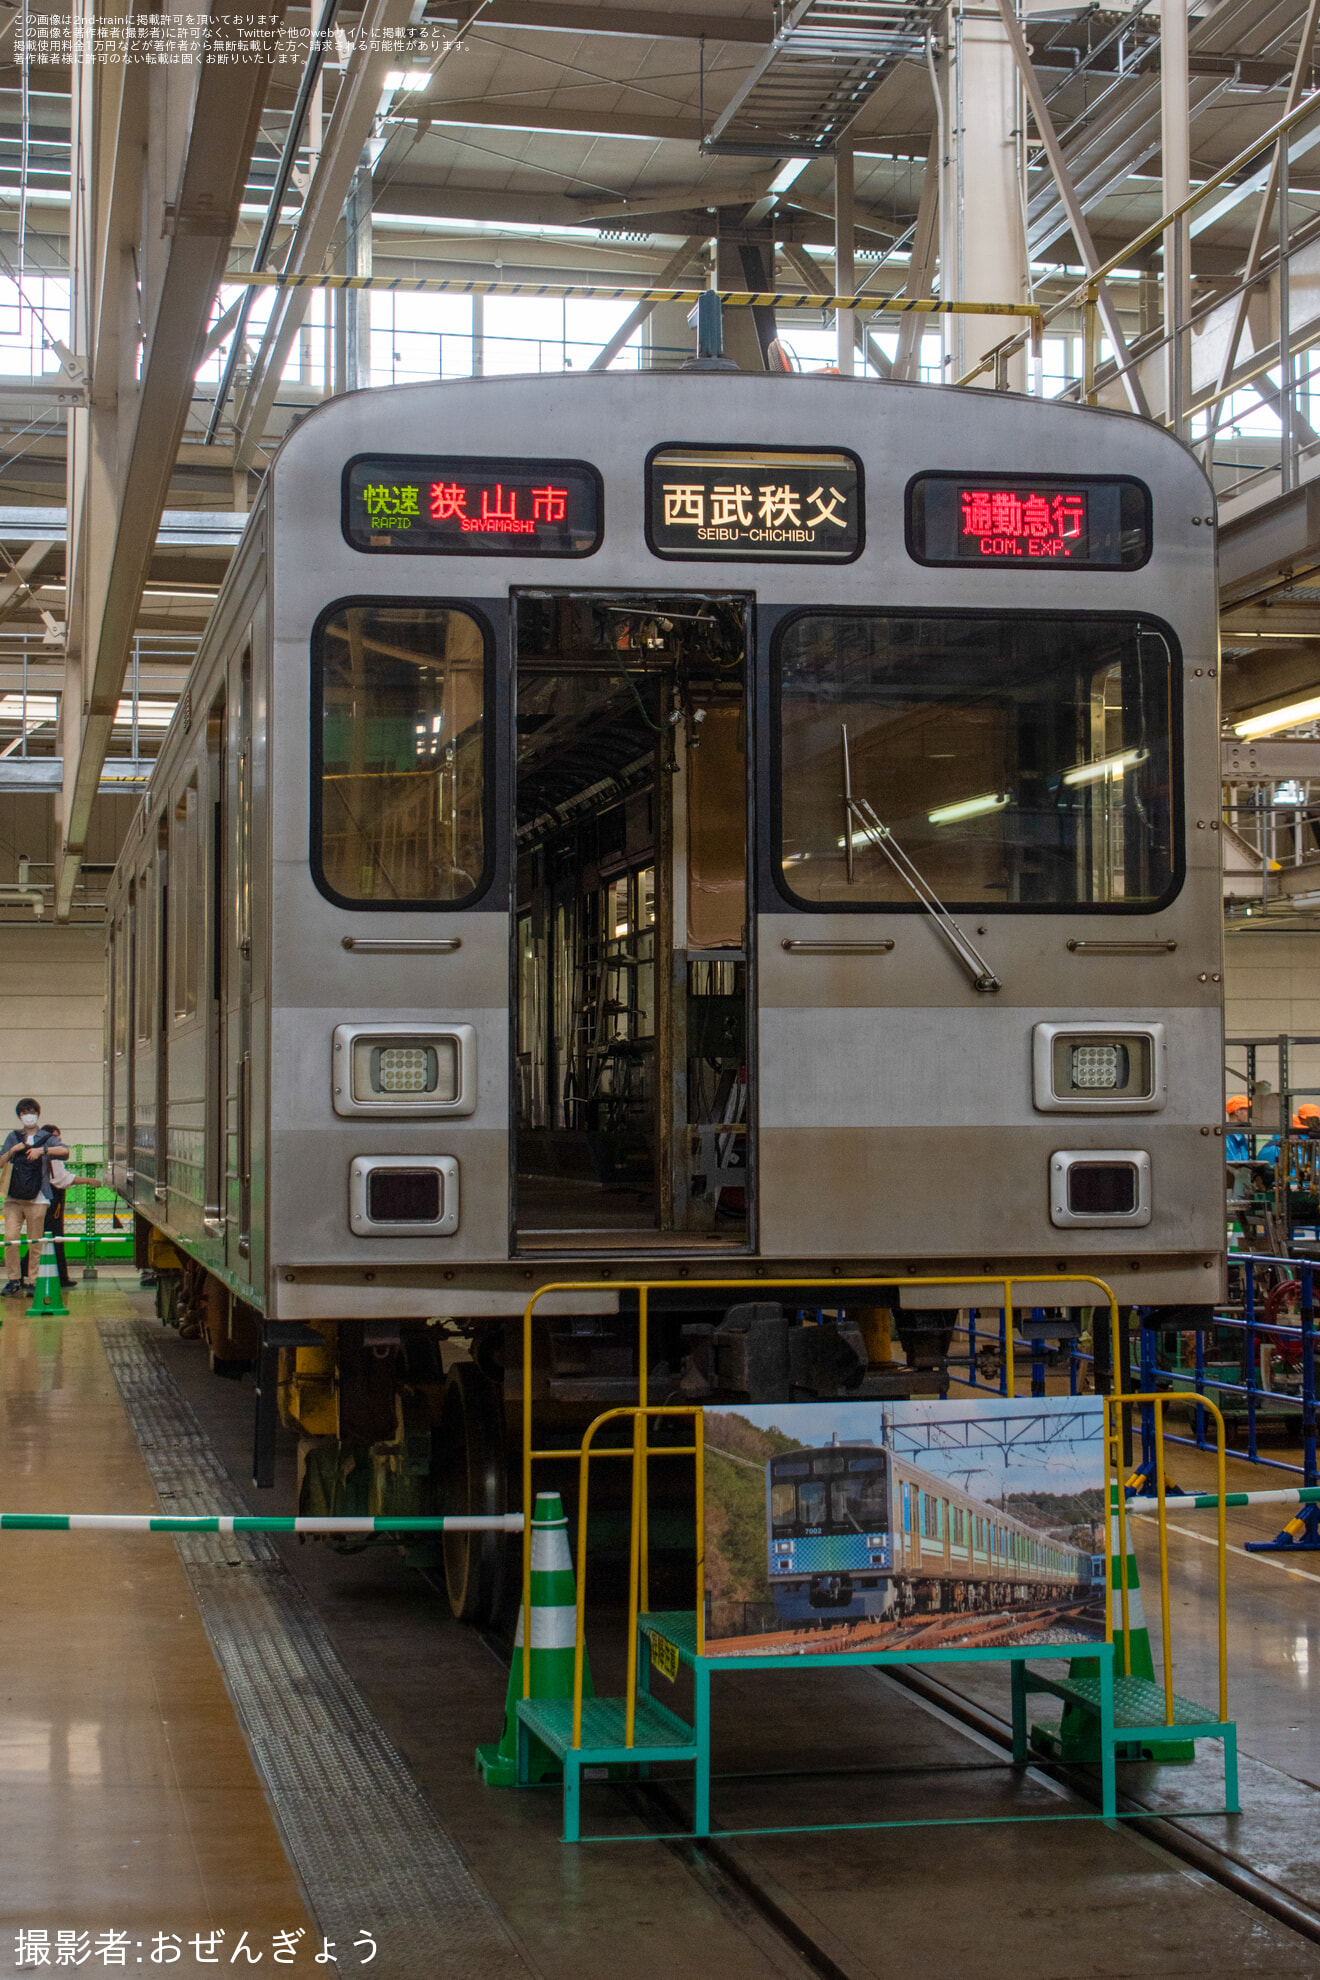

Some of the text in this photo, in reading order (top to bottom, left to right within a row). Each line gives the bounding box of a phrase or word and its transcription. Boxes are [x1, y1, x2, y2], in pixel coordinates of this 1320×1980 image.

[363, 482, 568, 522] 快速 狭山市
[662, 484, 848, 528] 西武秩父
[371, 516, 412, 530] RAPID
[961, 491, 1084, 538] 通勤急行
[460, 518, 536, 534] SAYAMASHI
[697, 528, 816, 543] SEIBU-CHICHIBU
[980, 537, 1071, 557] COM. EXP.
